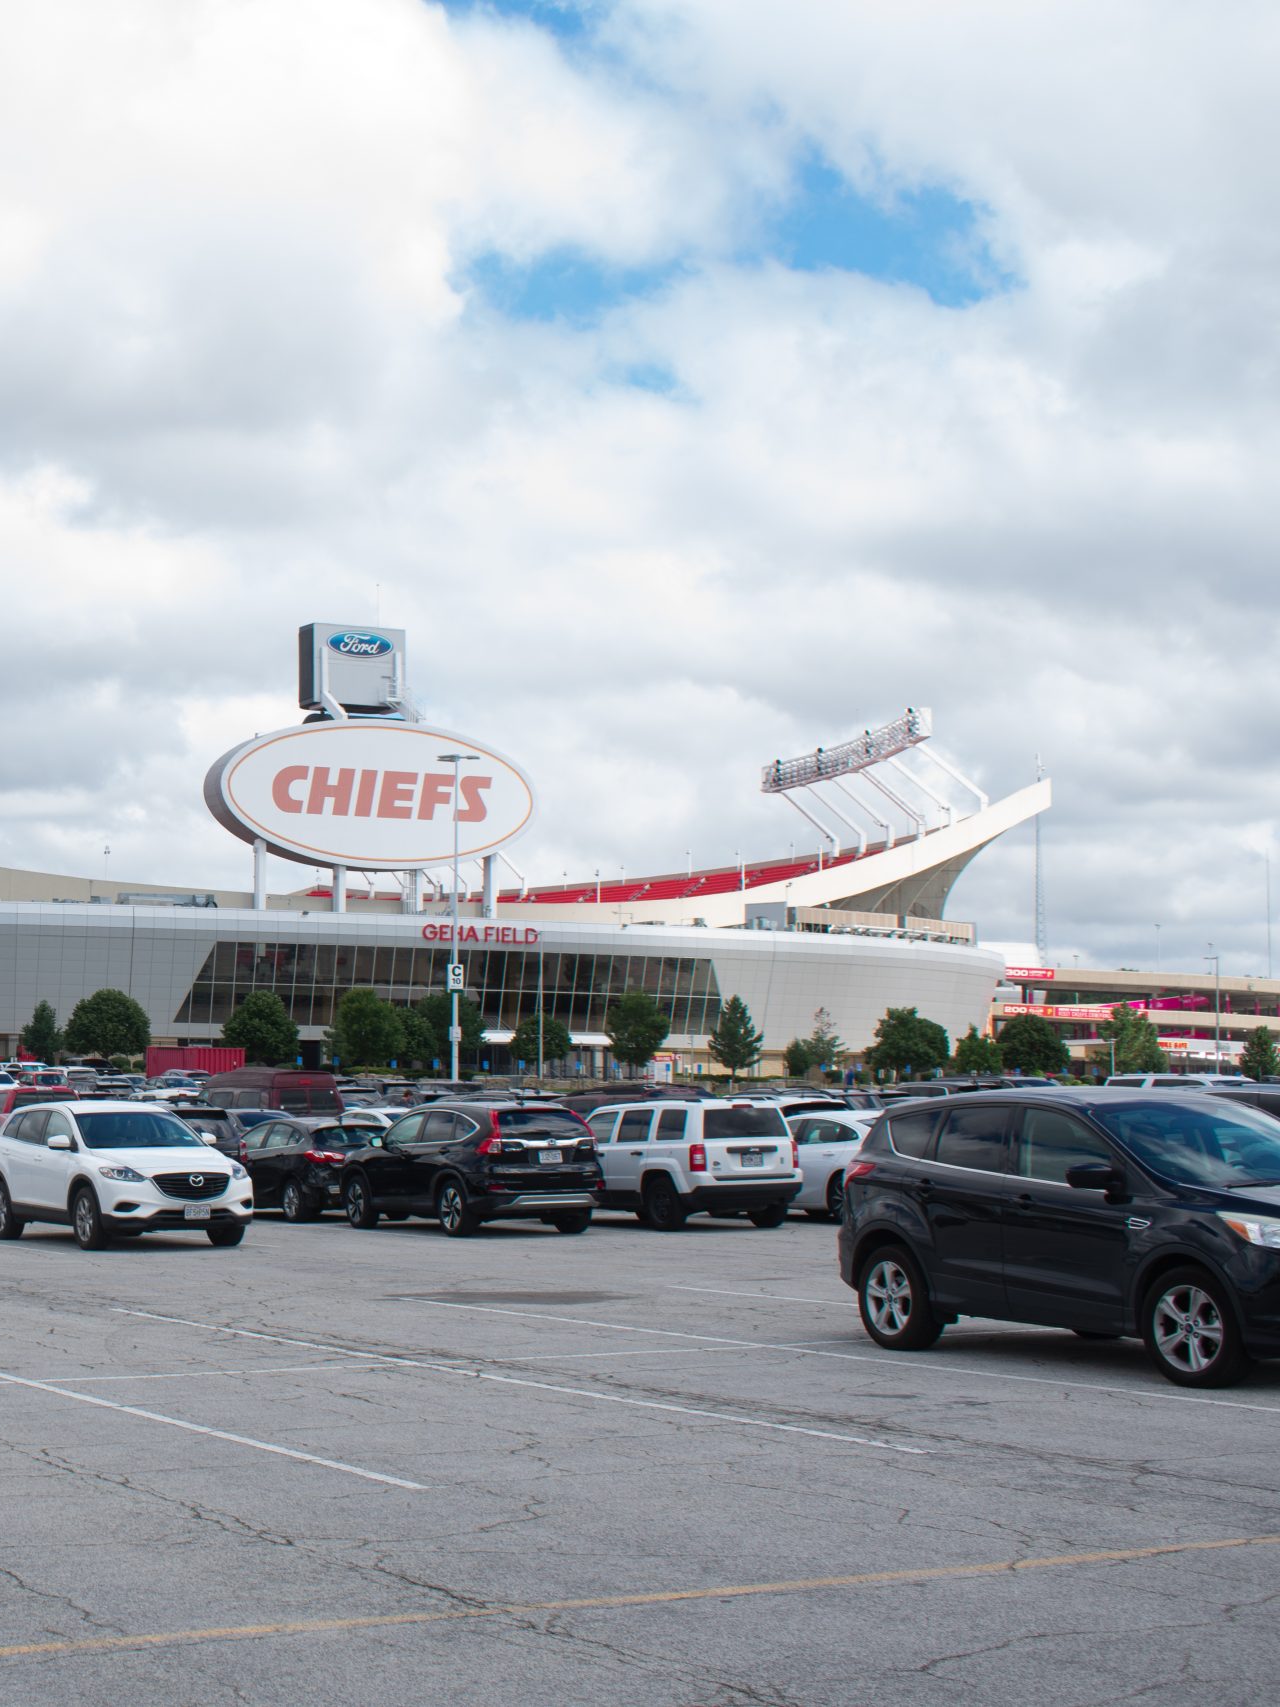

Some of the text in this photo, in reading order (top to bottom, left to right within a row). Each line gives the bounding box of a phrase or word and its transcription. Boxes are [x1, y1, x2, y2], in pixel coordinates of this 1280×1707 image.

[339, 633, 381, 654] Ford
[271, 765, 493, 823] CHIEFS
[422, 923, 539, 945] GEHA FIELD
[451, 966, 462, 977] C
[1006, 969, 1029, 977] 300
[1004, 1005, 1028, 1013] 200
